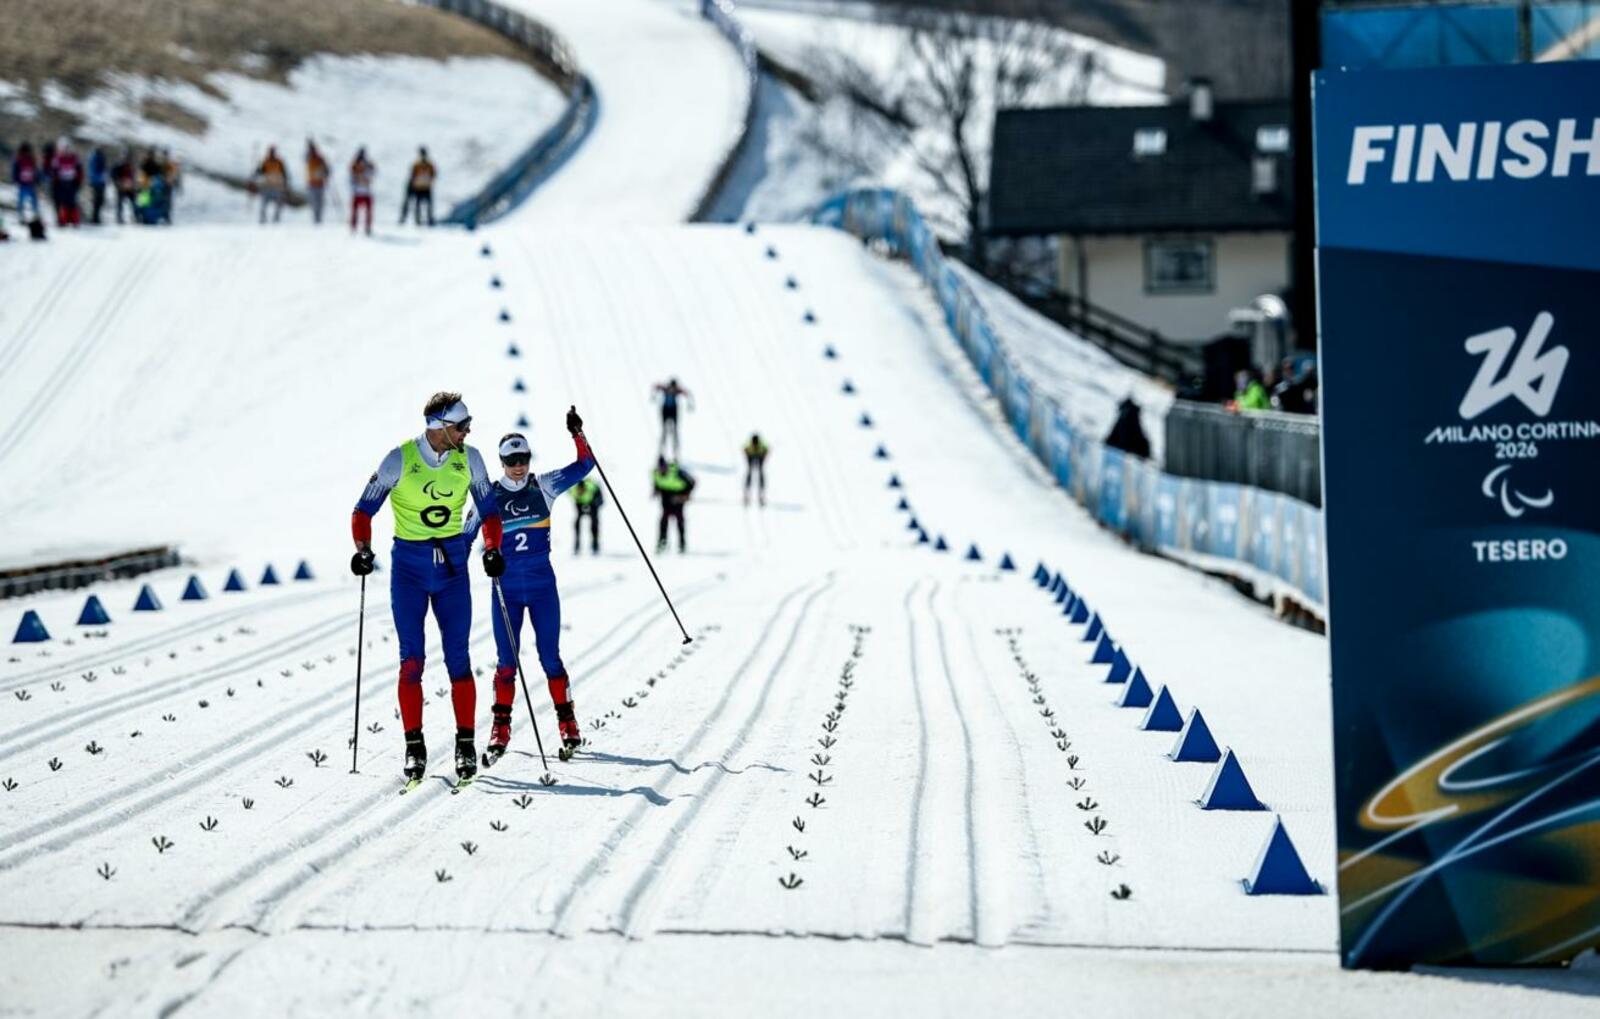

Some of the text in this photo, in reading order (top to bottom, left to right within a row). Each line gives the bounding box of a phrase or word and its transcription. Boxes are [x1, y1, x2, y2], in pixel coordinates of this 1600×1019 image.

[1348, 118, 1600, 184] FINISH
[1425, 424, 1514, 444] MILANO
[1495, 441, 1538, 459] 2026
[420, 505, 451, 528] G
[515, 532, 529, 553] 2
[1472, 538, 1568, 562] TESERO
